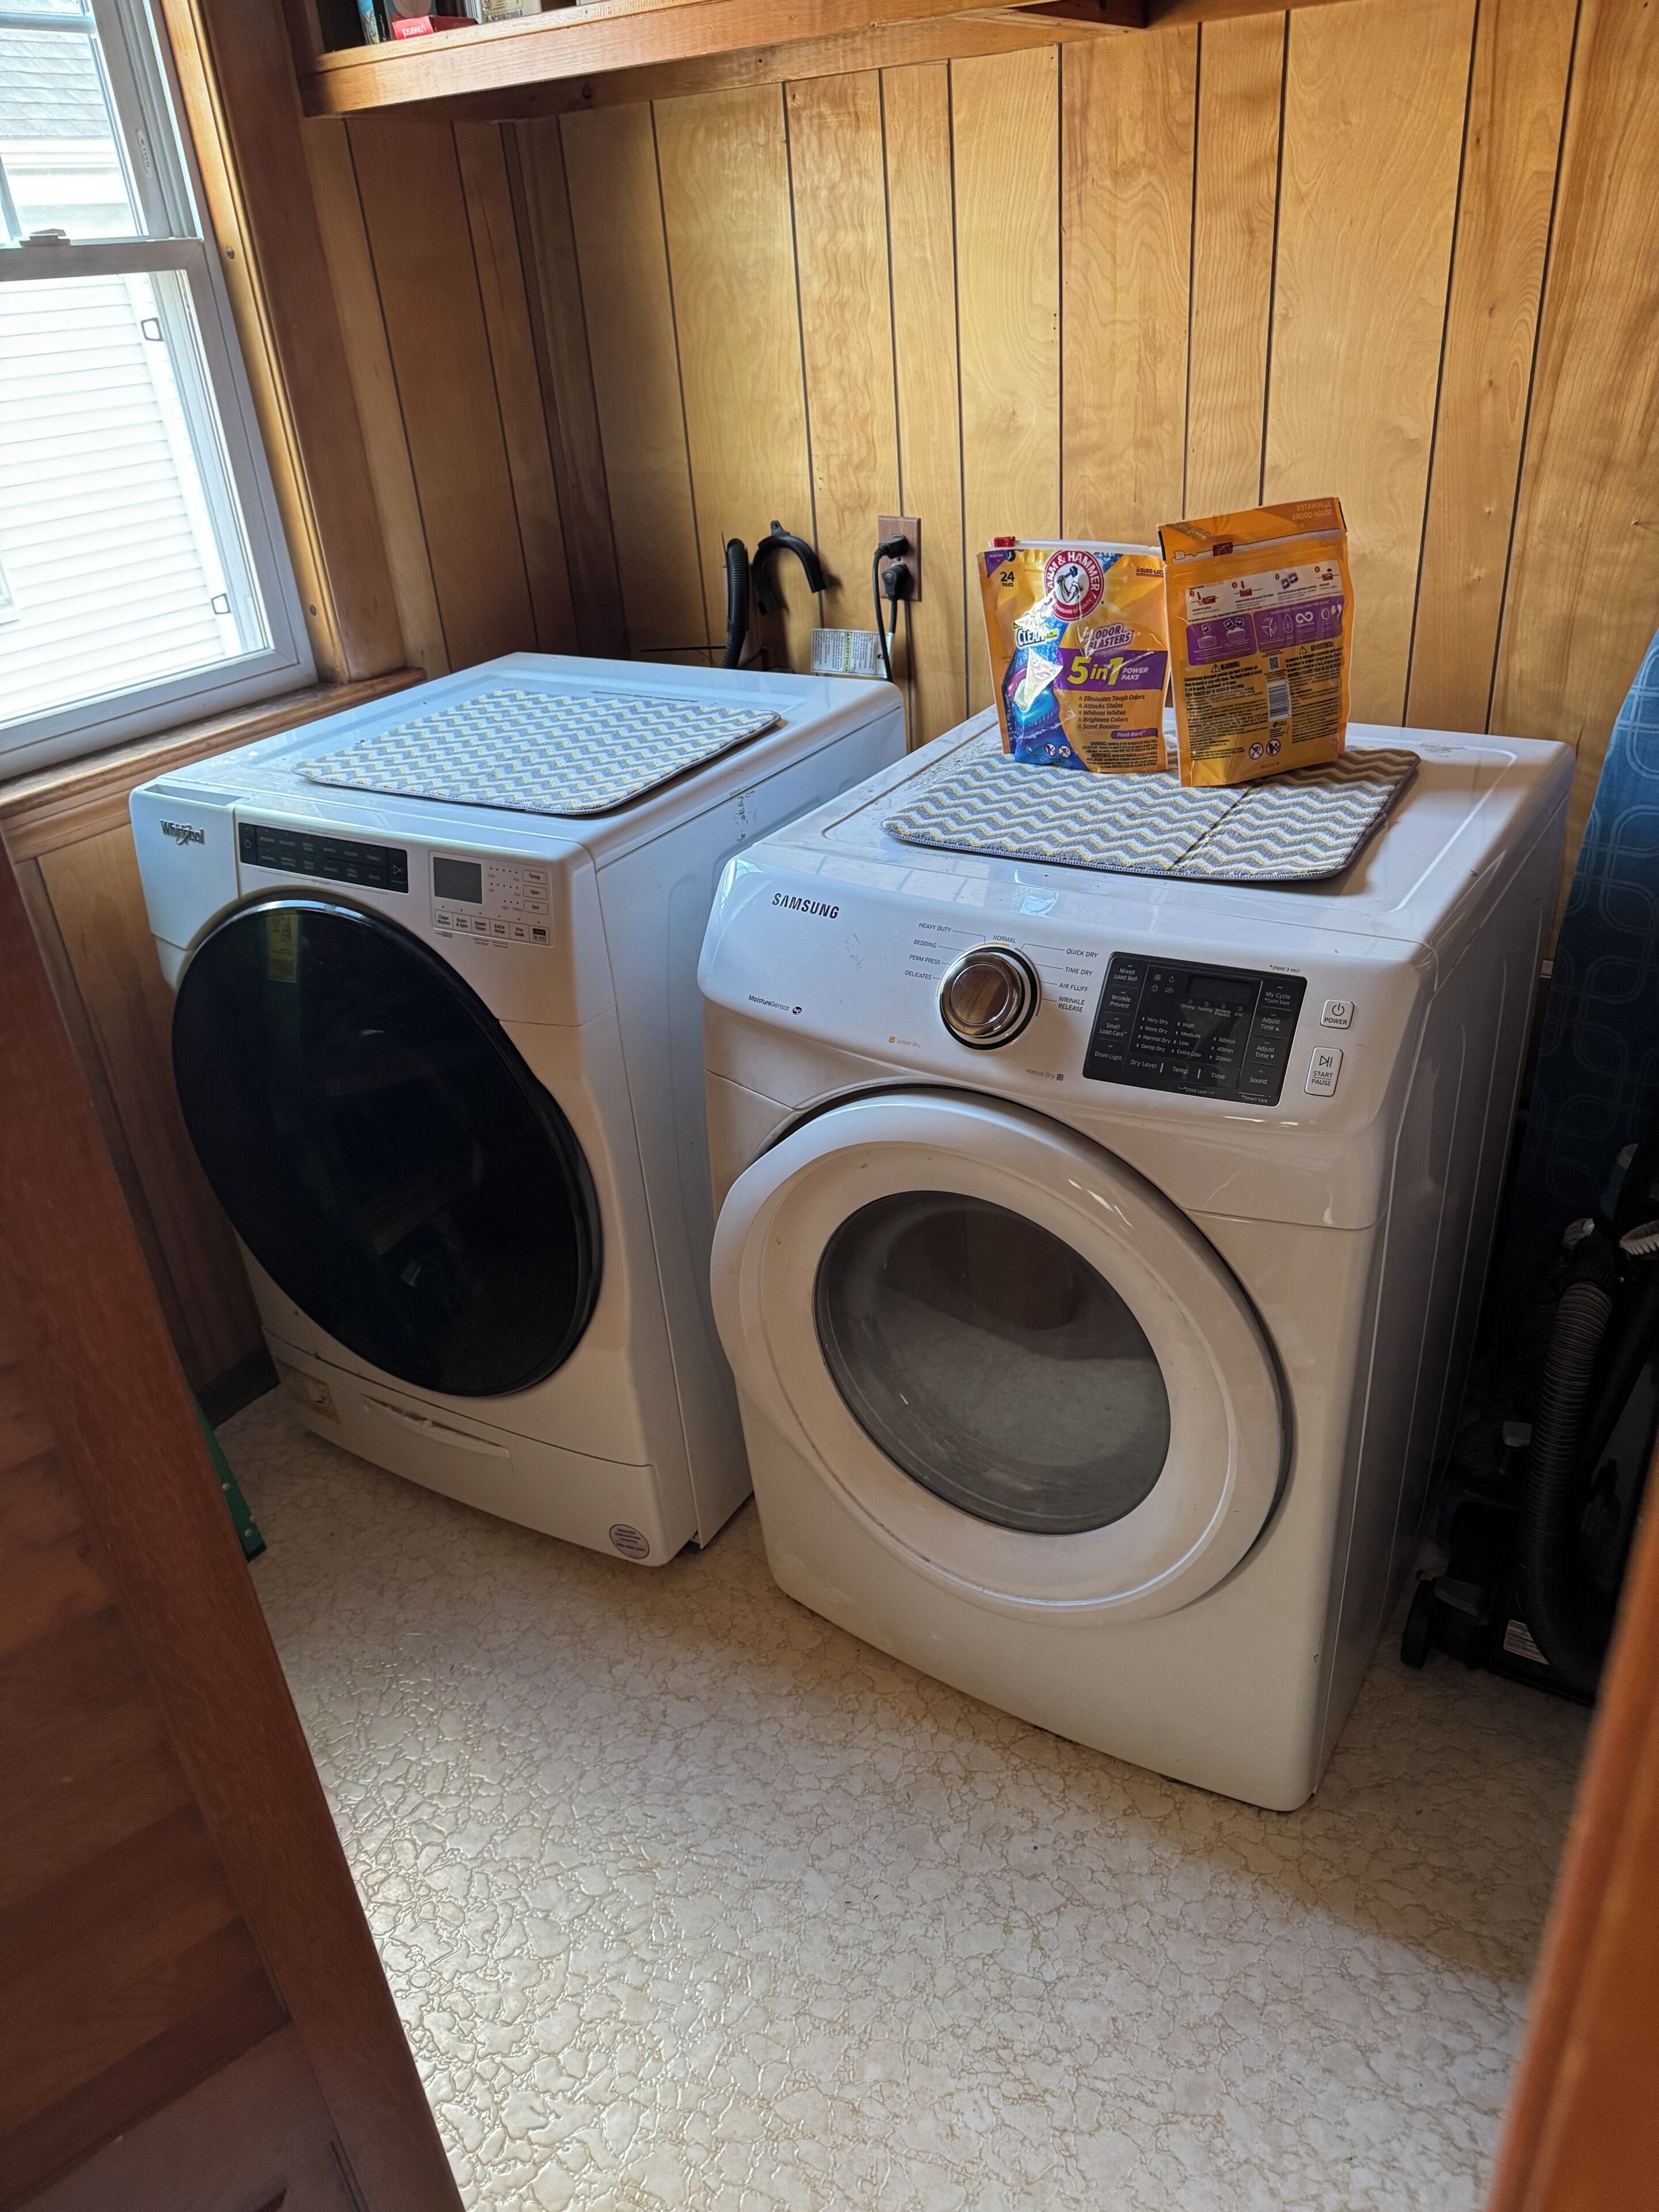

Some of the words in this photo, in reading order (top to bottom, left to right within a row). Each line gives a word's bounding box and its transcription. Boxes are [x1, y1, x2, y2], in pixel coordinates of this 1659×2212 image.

[1047, 561, 1059, 589] ARM
[1057, 555, 1066, 565] &
[1067, 551, 1100, 591] HAMMER
[1000, 571, 1015, 582] 24
[159, 819, 205, 845] Whirlpool
[772, 893, 839, 919] SAMSUNG
[914, 940, 937, 948] BEDDING
[993, 935, 1017, 944] NORMAL
[1066, 948, 1085, 956] QUICK
[909, 954, 924, 962] PERM
[905, 970, 931, 980] DELICATES
[1059, 996, 1085, 1005] WRINKLE
[1058, 1003, 1084, 1012] RELEASE
[1026, 1068, 1045, 1077] Manual
[1249, 1077, 1268, 1085] Sound
[1312, 1078, 1331, 1086] PAUSE
